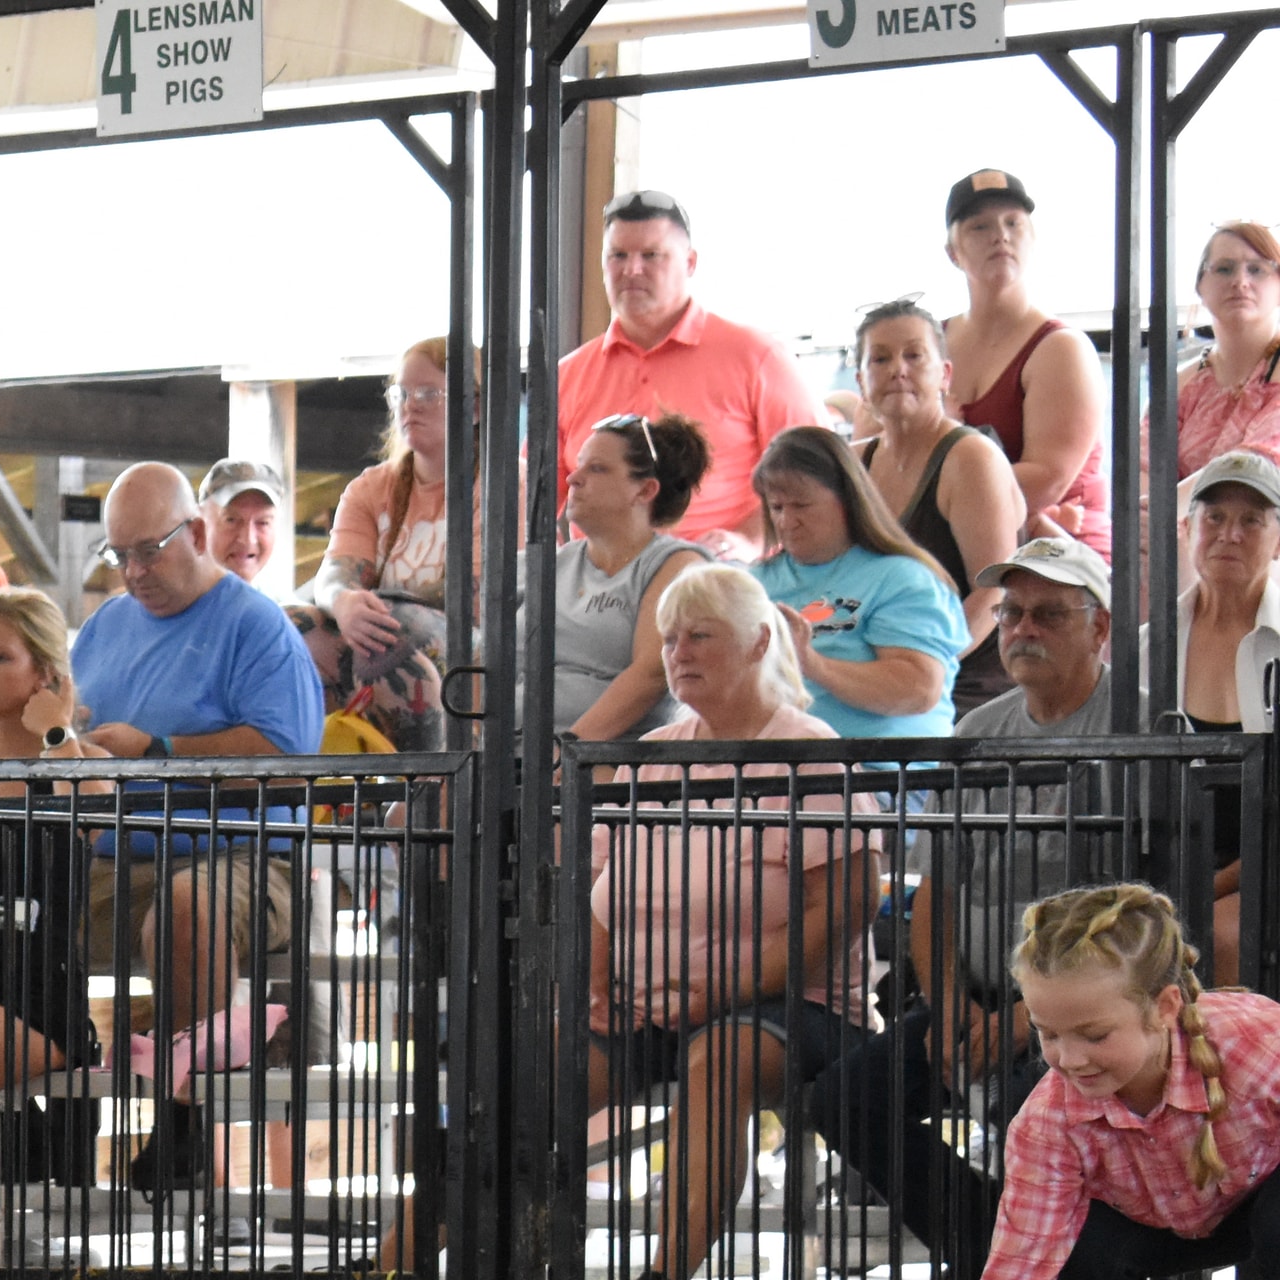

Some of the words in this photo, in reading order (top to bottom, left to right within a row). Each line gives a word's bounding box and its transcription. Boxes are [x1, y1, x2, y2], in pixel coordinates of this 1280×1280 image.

[133, 0, 255, 33] LENSMAN
[877, 2, 977, 37] MEATS
[101, 8, 137, 115] 4
[157, 37, 232, 68] SHOW
[166, 76, 224, 105] PIGS
